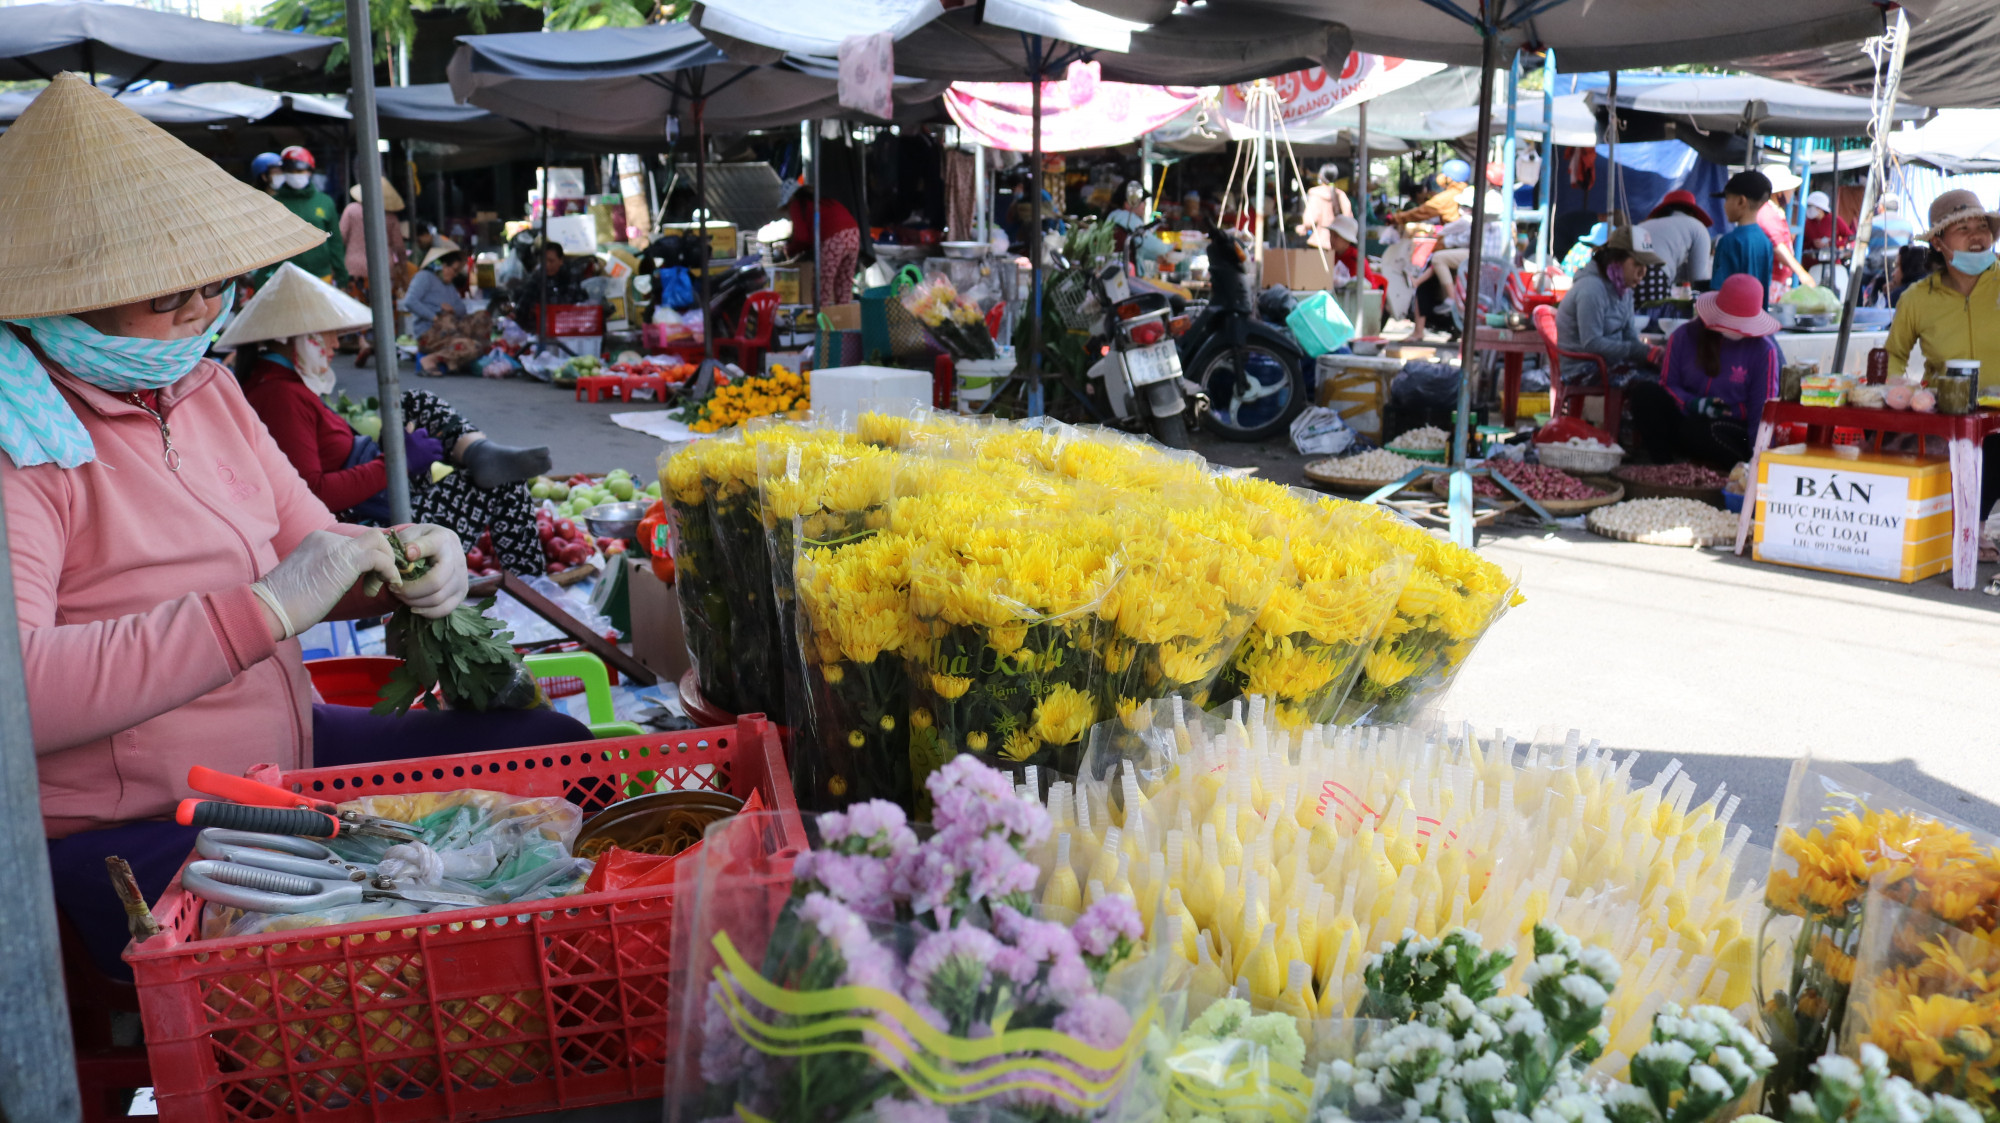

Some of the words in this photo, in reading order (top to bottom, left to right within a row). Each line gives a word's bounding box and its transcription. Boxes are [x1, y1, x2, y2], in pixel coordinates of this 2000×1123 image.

[1794, 474, 1874, 504] BÁN
[1769, 501, 1808, 519] THỰC
[1858, 512, 1901, 529] CHAY
[1795, 520, 1825, 537] CÁC
[1832, 526, 1869, 545] LOẠI
[1814, 542, 1835, 552] 0917
[1854, 546, 1870, 556] 644
